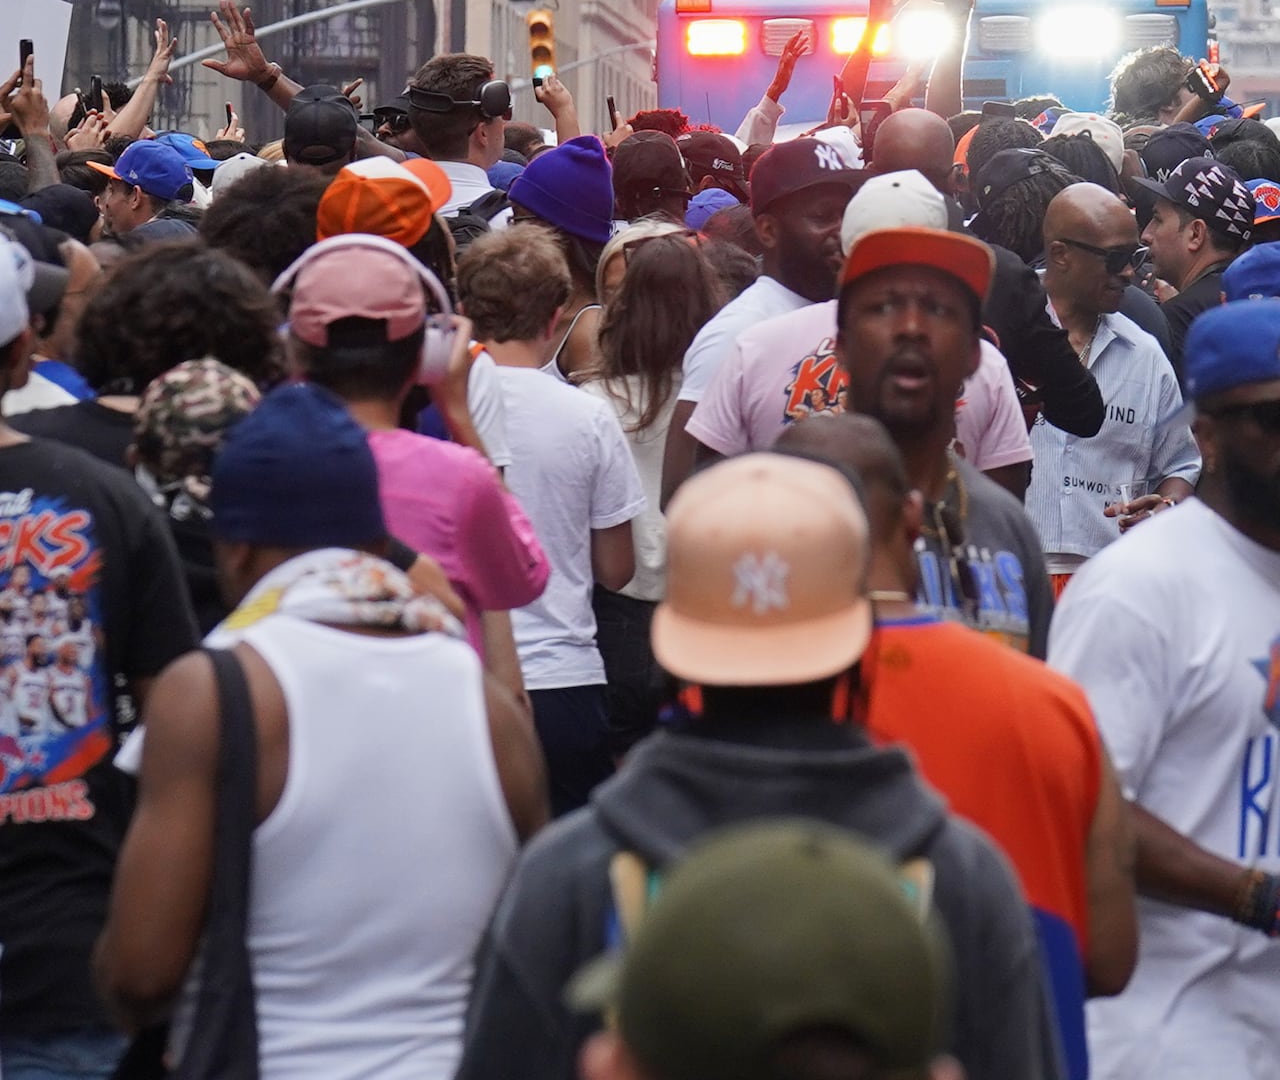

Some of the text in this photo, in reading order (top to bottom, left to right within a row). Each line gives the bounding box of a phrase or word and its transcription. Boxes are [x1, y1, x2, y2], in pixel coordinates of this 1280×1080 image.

[814, 144, 842, 170] NY
[1105, 404, 1135, 425] IND
[731, 552, 790, 613] NY
